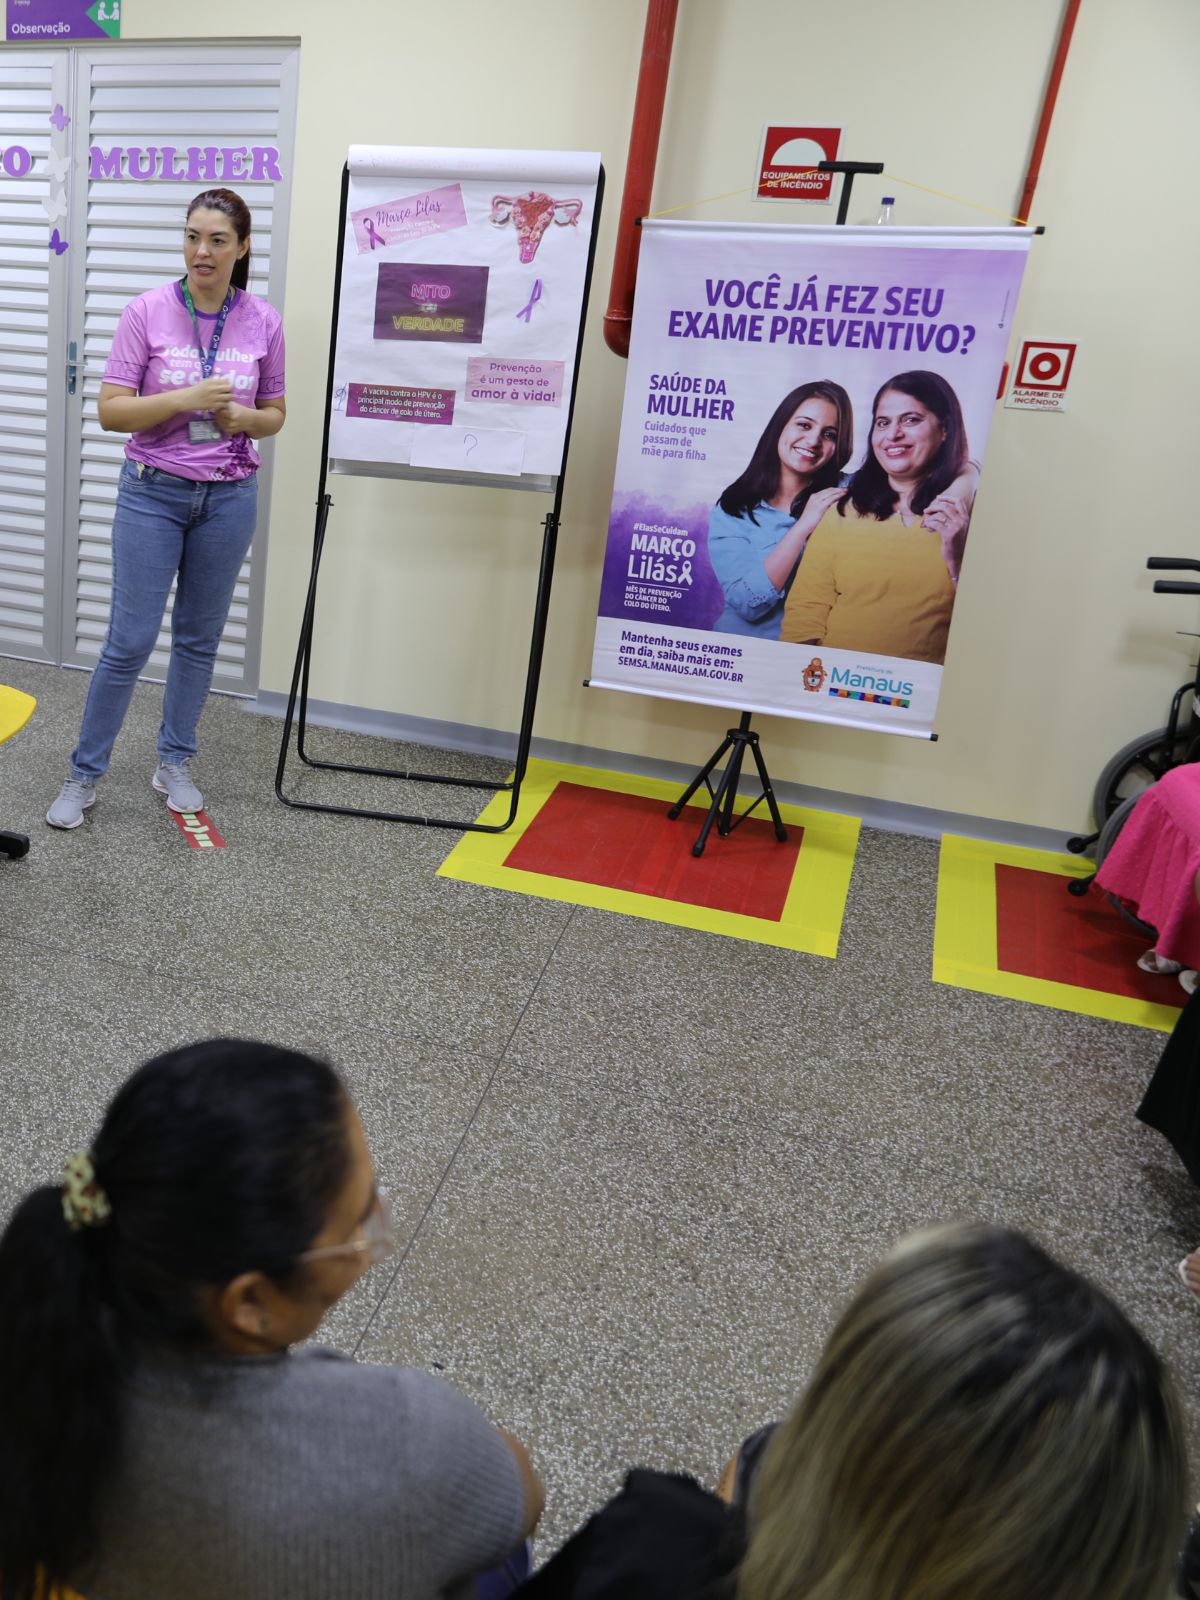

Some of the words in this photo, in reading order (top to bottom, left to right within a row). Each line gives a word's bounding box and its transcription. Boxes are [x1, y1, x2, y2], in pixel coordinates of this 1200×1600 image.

[11, 22, 71, 35] Observação
[89, 146, 283, 181] MULHER
[762, 171, 831, 181] EQUIPAMENTOS
[767, 180, 779, 188] DE
[780, 180, 823, 190] INCÊNDIO
[376, 208, 411, 227] Março
[411, 284, 451, 299] MITO
[705, 273, 781, 310] VOCÊ
[783, 274, 818, 312] JÁ
[825, 284, 879, 314] FEZ
[882, 286, 945, 318] SEU
[392, 315, 465, 333] VERDADE
[668, 310, 765, 342] EXAME
[769, 315, 976, 355] PREVENTIVO?
[490, 363, 542, 375] Prevenção
[159, 369, 186, 385] se
[188, 367, 255, 390] cidar
[480, 375, 486, 383] é
[506, 377, 534, 386] gesto
[536, 378, 549, 386] de
[649, 371, 702, 394] SAÚDE
[704, 378, 727, 395] DA
[369, 388, 389, 396] vacina
[390, 389, 410, 397] contra
[417, 390, 430, 398] HPV
[432, 391, 437, 399] é
[471, 389, 507, 399] amor
[511, 389, 518, 400] à
[523, 390, 556, 402] vida!
[1012, 390, 1049, 398] ALARME
[358, 396, 384, 405] principal
[412, 401, 446, 410] prevenção
[647, 393, 735, 421] MULHER
[1014, 398, 1059, 406] INCÊNDIO
[369, 406, 389, 415] câncer
[414, 409, 422, 417] de
[644, 420, 687, 434] Cuidados
[689, 426, 707, 437] que
[642, 434, 679, 446] passam
[680, 436, 692, 447] de
[641, 445, 661, 456] mãe
[662, 448, 683, 460] para
[685, 449, 707, 461] filha
[633, 522, 688, 536] #ElasSeCuidam
[630, 533, 696, 561] MARÇO
[627, 554, 678, 583] Lilás
[624, 592, 634, 600] DO
[634, 593, 657, 603] CÂNCER
[625, 585, 638, 593] MÊS
[638, 586, 647, 594] DE
[647, 587, 682, 599] PREVENÇÃO
[624, 600, 640, 608] COLO
[650, 602, 671, 612] ÚTERO.
[621, 630, 674, 648] Mantenha
[675, 640, 700, 652] seus
[701, 644, 743, 657] exames
[619, 645, 636, 655] em
[637, 646, 655, 660] dia,
[657, 649, 685, 663] saiba
[686, 654, 711, 666] mais
[713, 658, 734, 669] em:
[618, 656, 744, 683] SEMSA.MANAUS.AM.GOV.BR
[830, 666, 914, 696] Manaus
